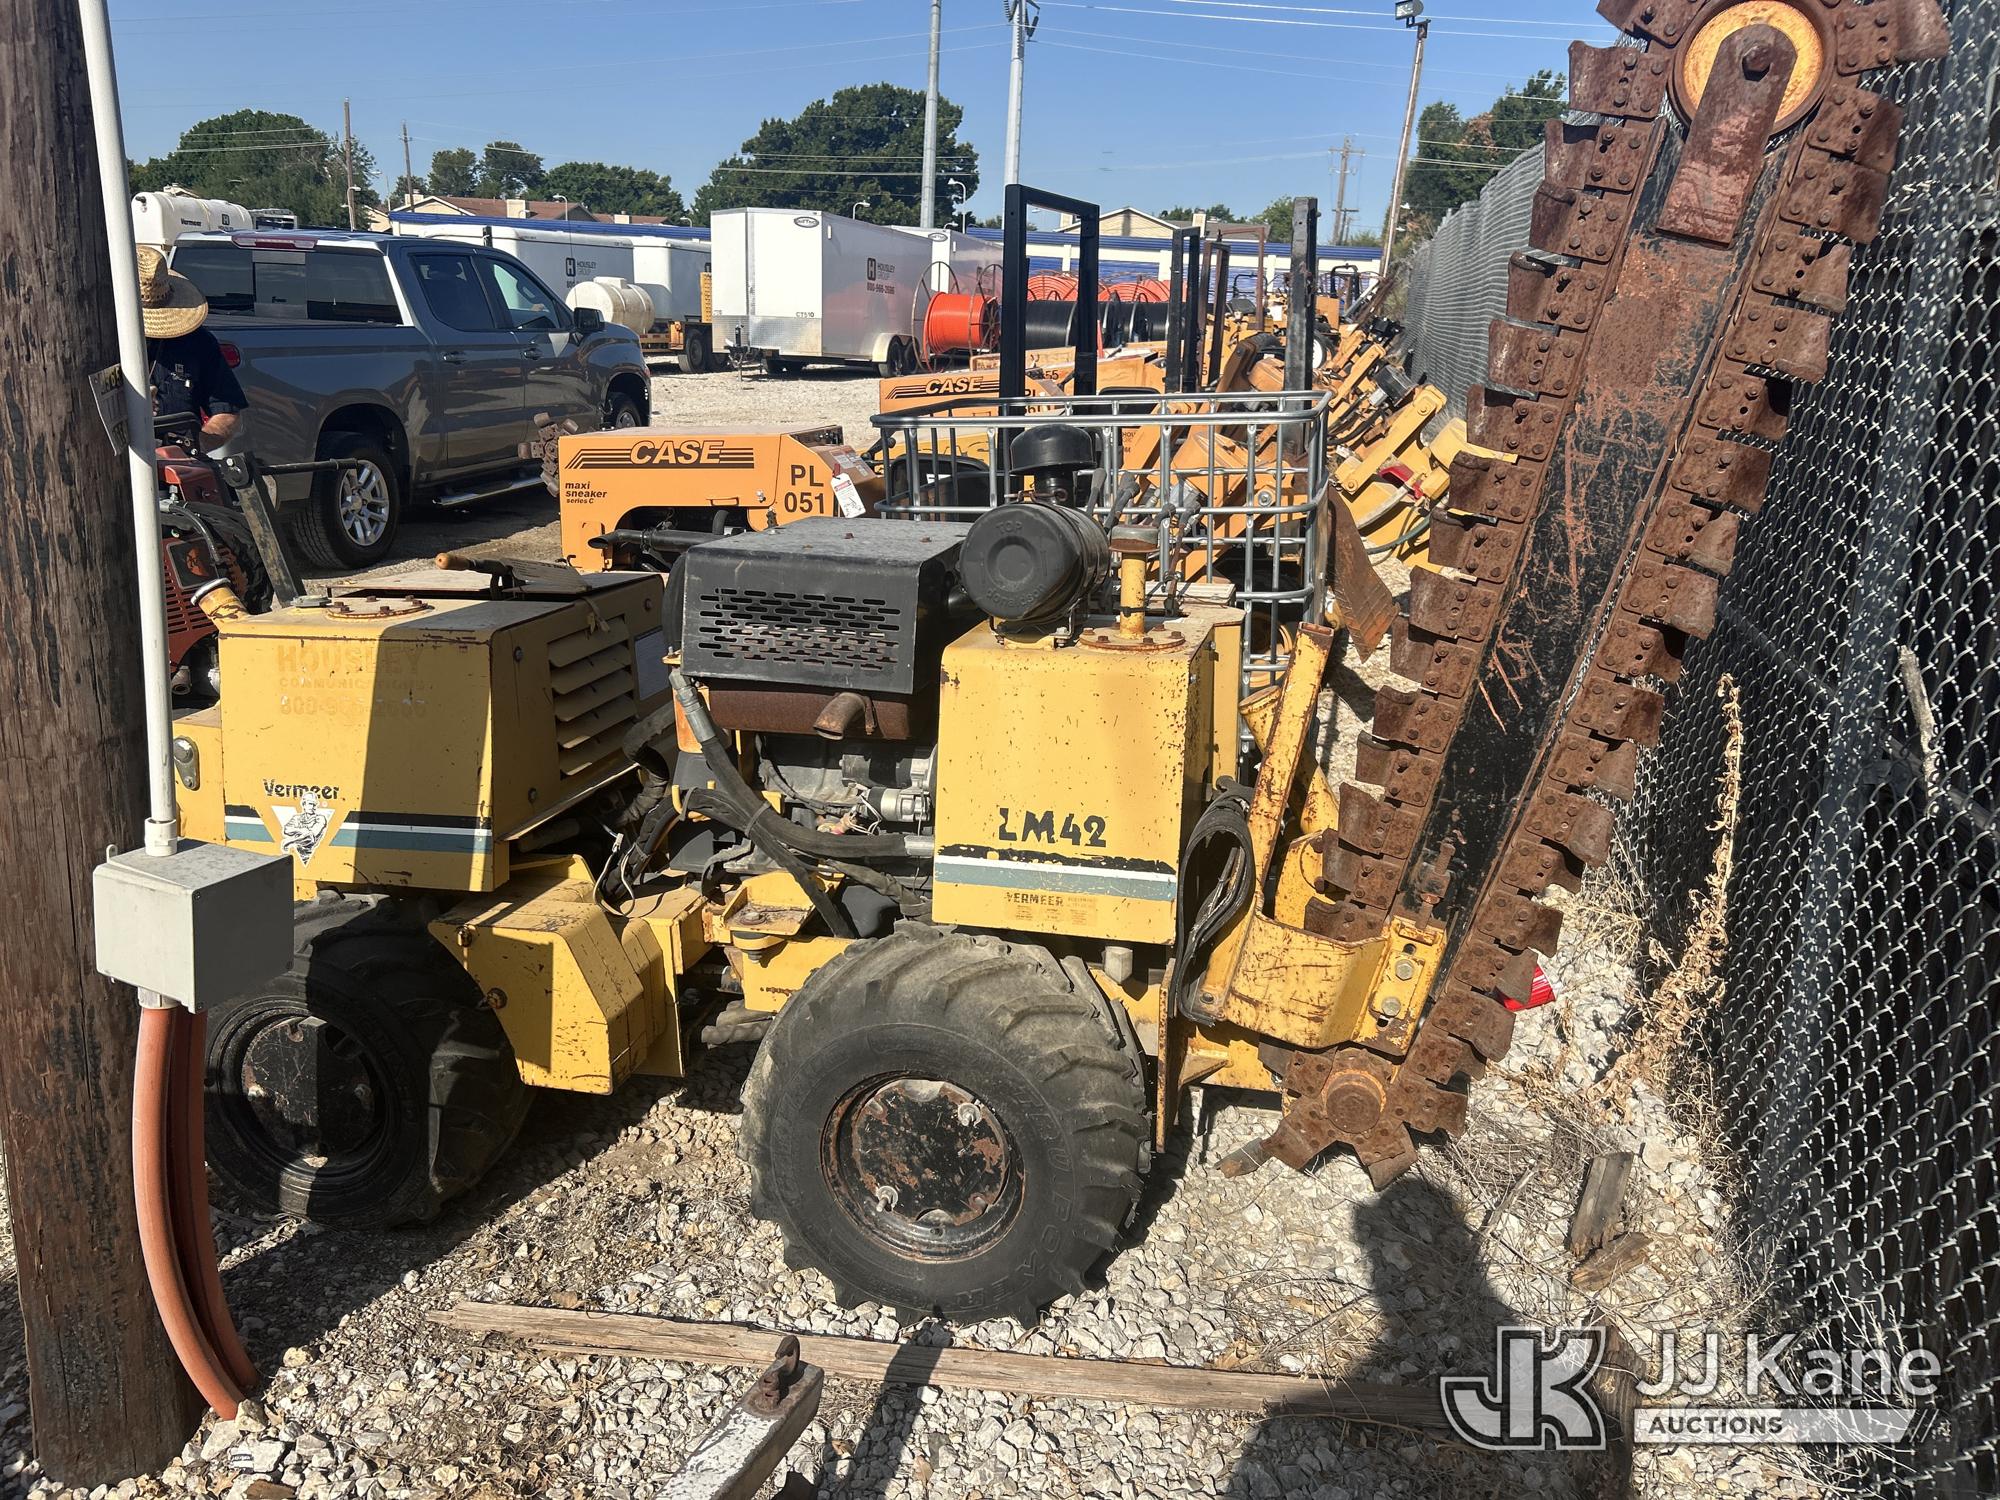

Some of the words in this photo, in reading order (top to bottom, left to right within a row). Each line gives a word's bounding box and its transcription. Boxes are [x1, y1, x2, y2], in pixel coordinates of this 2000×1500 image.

[925, 376, 984, 395] CASE
[630, 440, 724, 464] CASE
[565, 481, 591, 490] maxi
[790, 464, 824, 487] PL
[565, 490, 608, 498] sneaker
[784, 491, 825, 514] 051
[996, 520, 1023, 534] TOP
[263, 778, 340, 800] Vermeer
[998, 807, 1107, 848] LM42
[1005, 891, 1064, 907] VERMEER
